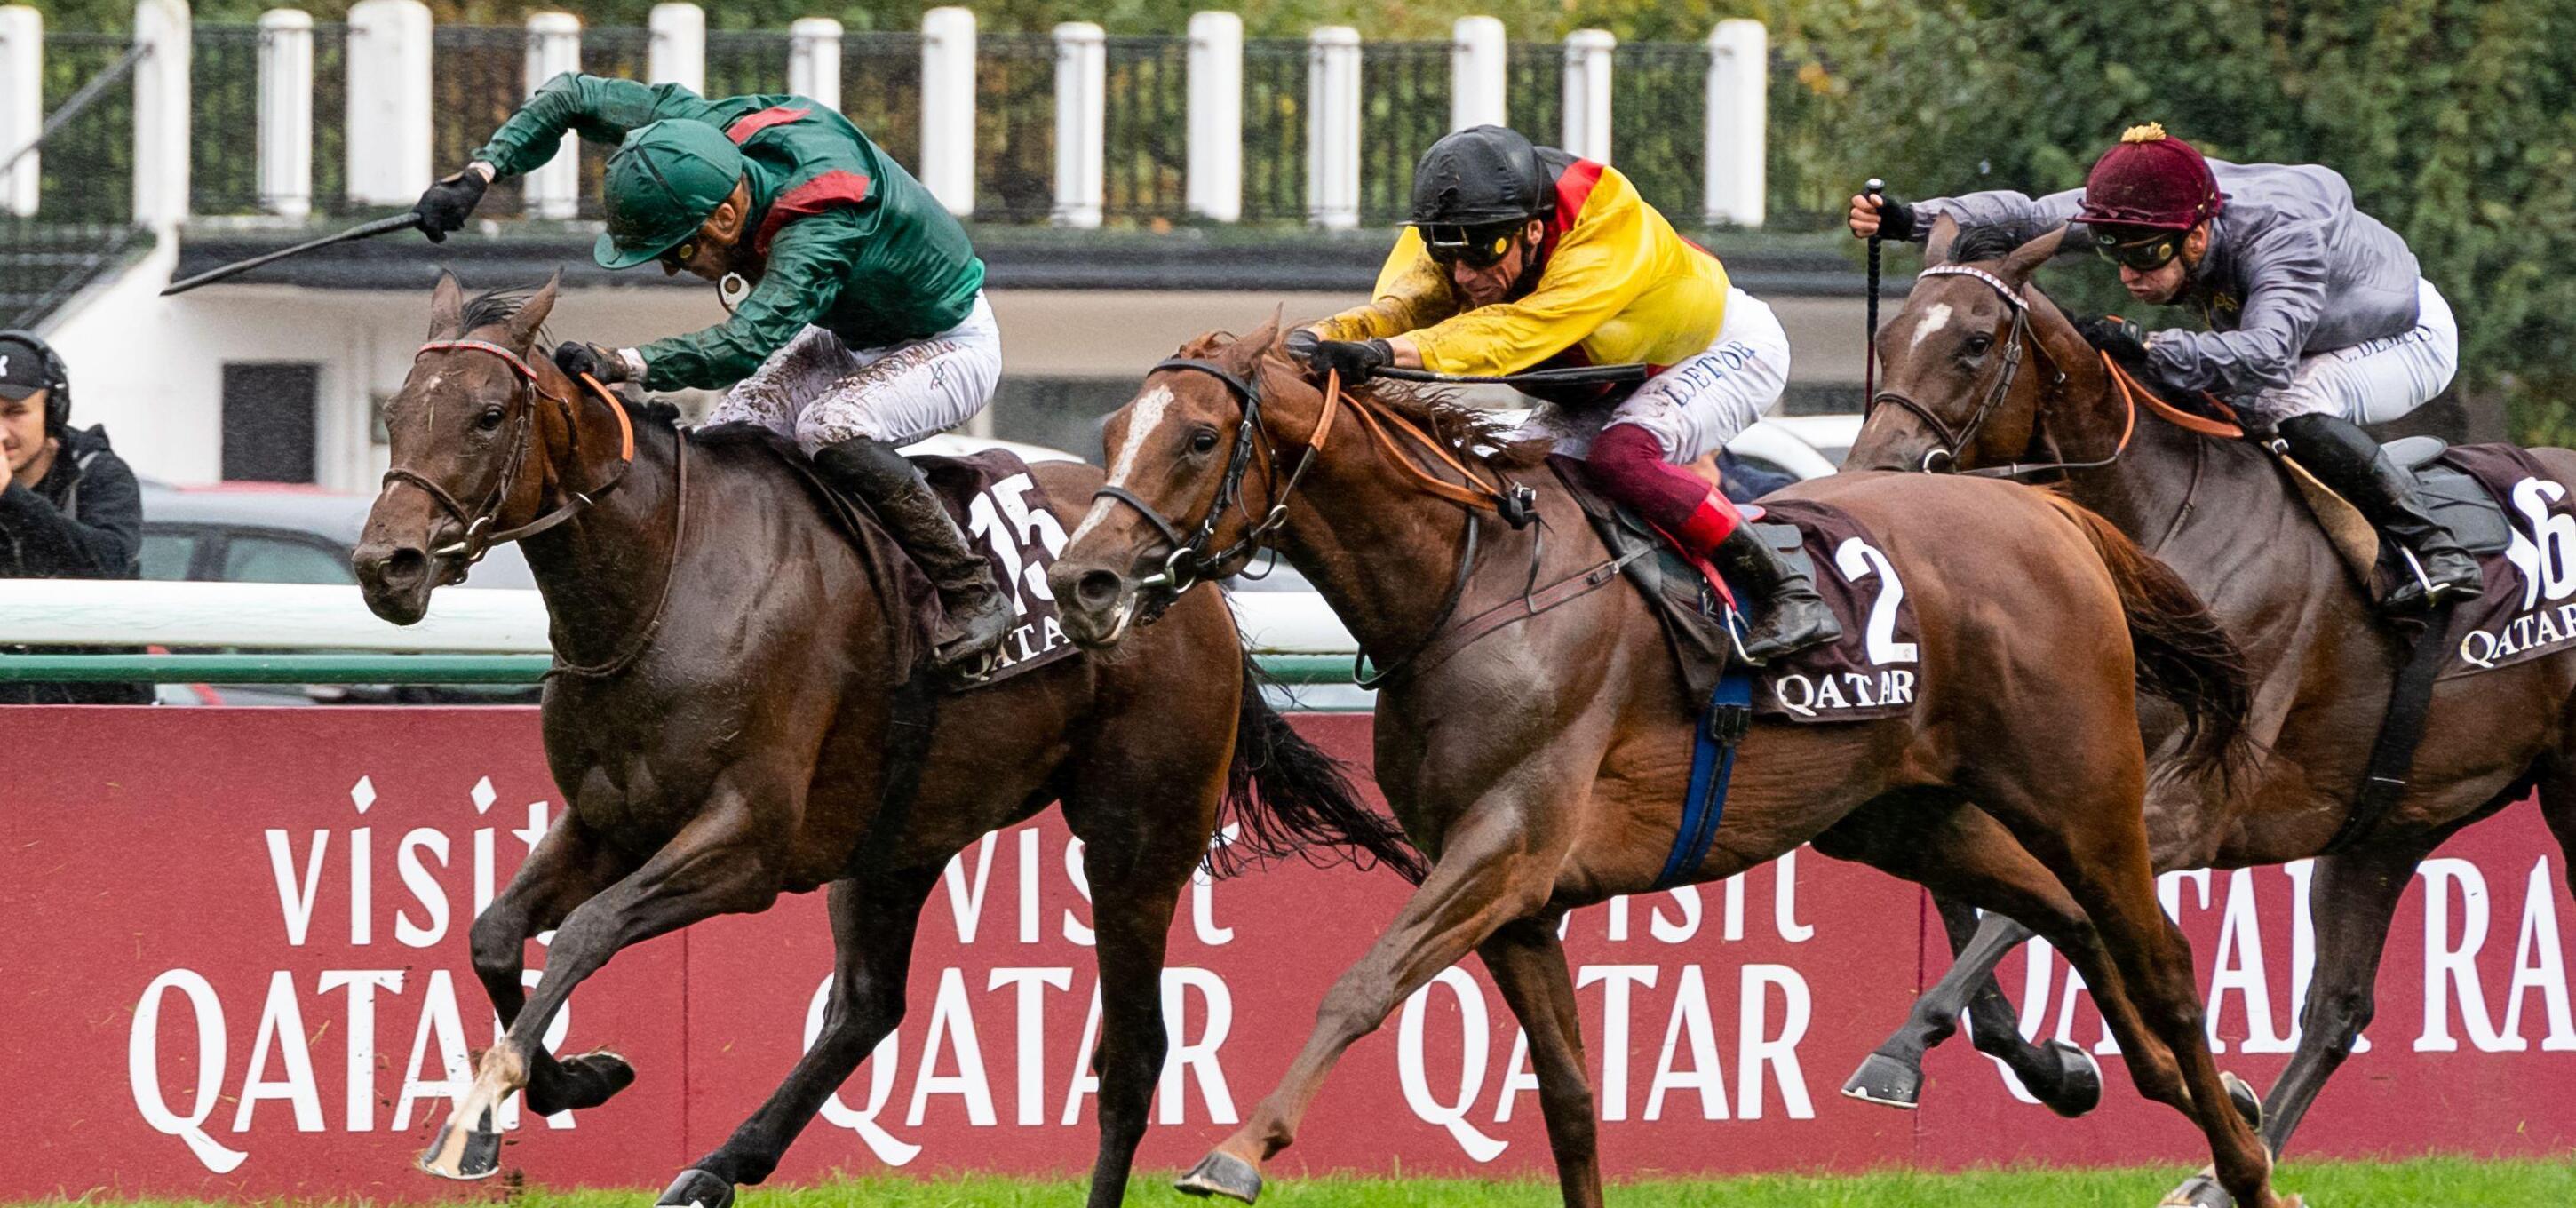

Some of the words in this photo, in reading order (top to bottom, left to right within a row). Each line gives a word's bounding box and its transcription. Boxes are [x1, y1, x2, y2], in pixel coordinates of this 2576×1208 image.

[968, 473, 1069, 616] 15
[1835, 536, 1918, 666] 2
[980, 616, 1071, 681] ATA
[1777, 670, 1915, 717] QATAR
[943, 820, 1239, 947] vist
